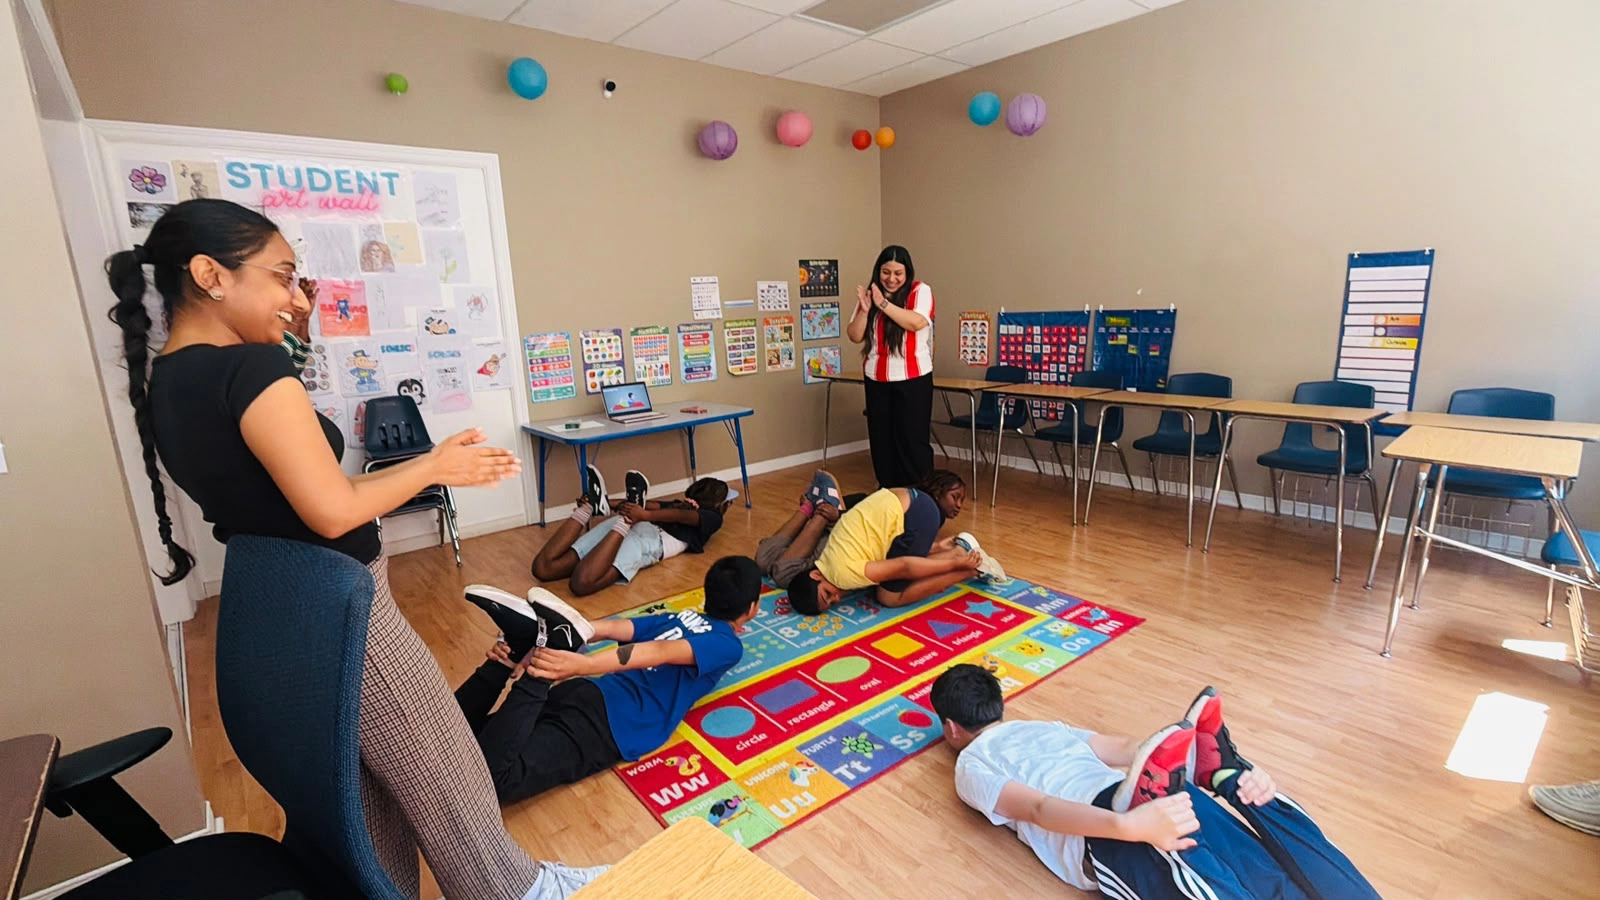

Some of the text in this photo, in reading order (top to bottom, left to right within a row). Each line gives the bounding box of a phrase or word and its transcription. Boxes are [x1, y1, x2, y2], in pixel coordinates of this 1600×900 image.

[226, 161, 399, 196] STUDENT
[262, 186, 379, 211] art wall
[1035, 598, 1069, 613] Mm
[1001, 613, 1016, 623] star
[1093, 619, 1124, 634] Nn
[779, 626, 801, 638] 8
[952, 629, 984, 647] triangle
[1061, 637, 1091, 652] Oo
[734, 659, 763, 674] seven
[909, 650, 939, 669] square
[1023, 657, 1057, 674] Pp
[859, 677, 882, 691] oval
[786, 699, 836, 727] rectangle
[735, 732, 768, 751] circle
[801, 735, 838, 757] TURTLE
[890, 729, 927, 751] Ss
[626, 757, 664, 777] WORM
[744, 761, 790, 787] UNICORN
[832, 759, 872, 781] Tt
[649, 772, 710, 807] Ww
[769, 791, 817, 820] Uu
